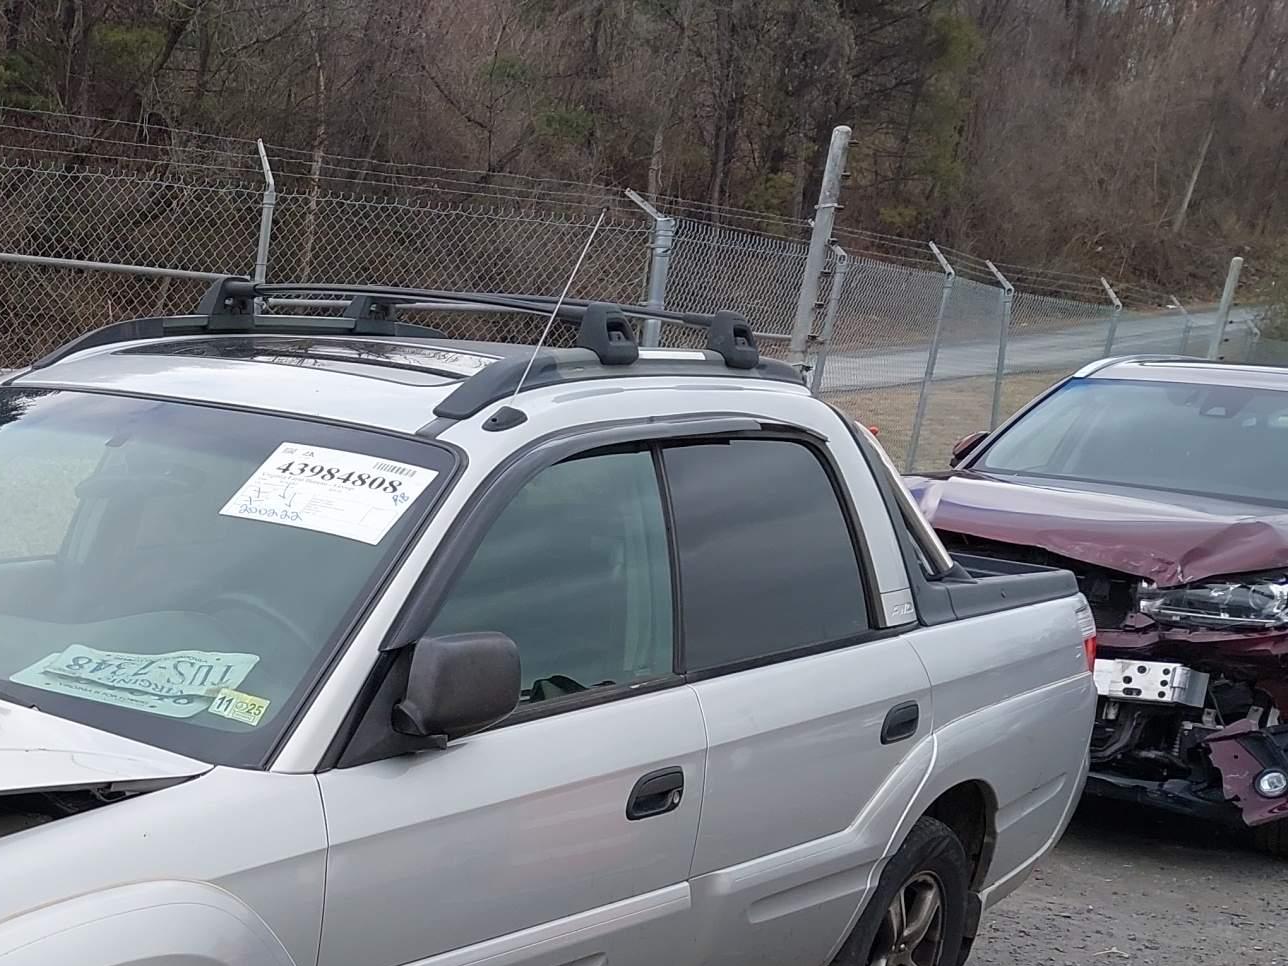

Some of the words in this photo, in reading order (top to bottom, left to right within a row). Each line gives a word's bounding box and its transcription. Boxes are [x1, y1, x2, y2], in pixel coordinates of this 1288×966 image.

[276, 461, 402, 493] 43984808
[65, 656, 234, 686] TUS-7348
[216, 695, 234, 712] 11
[246, 703, 265, 716] 25
